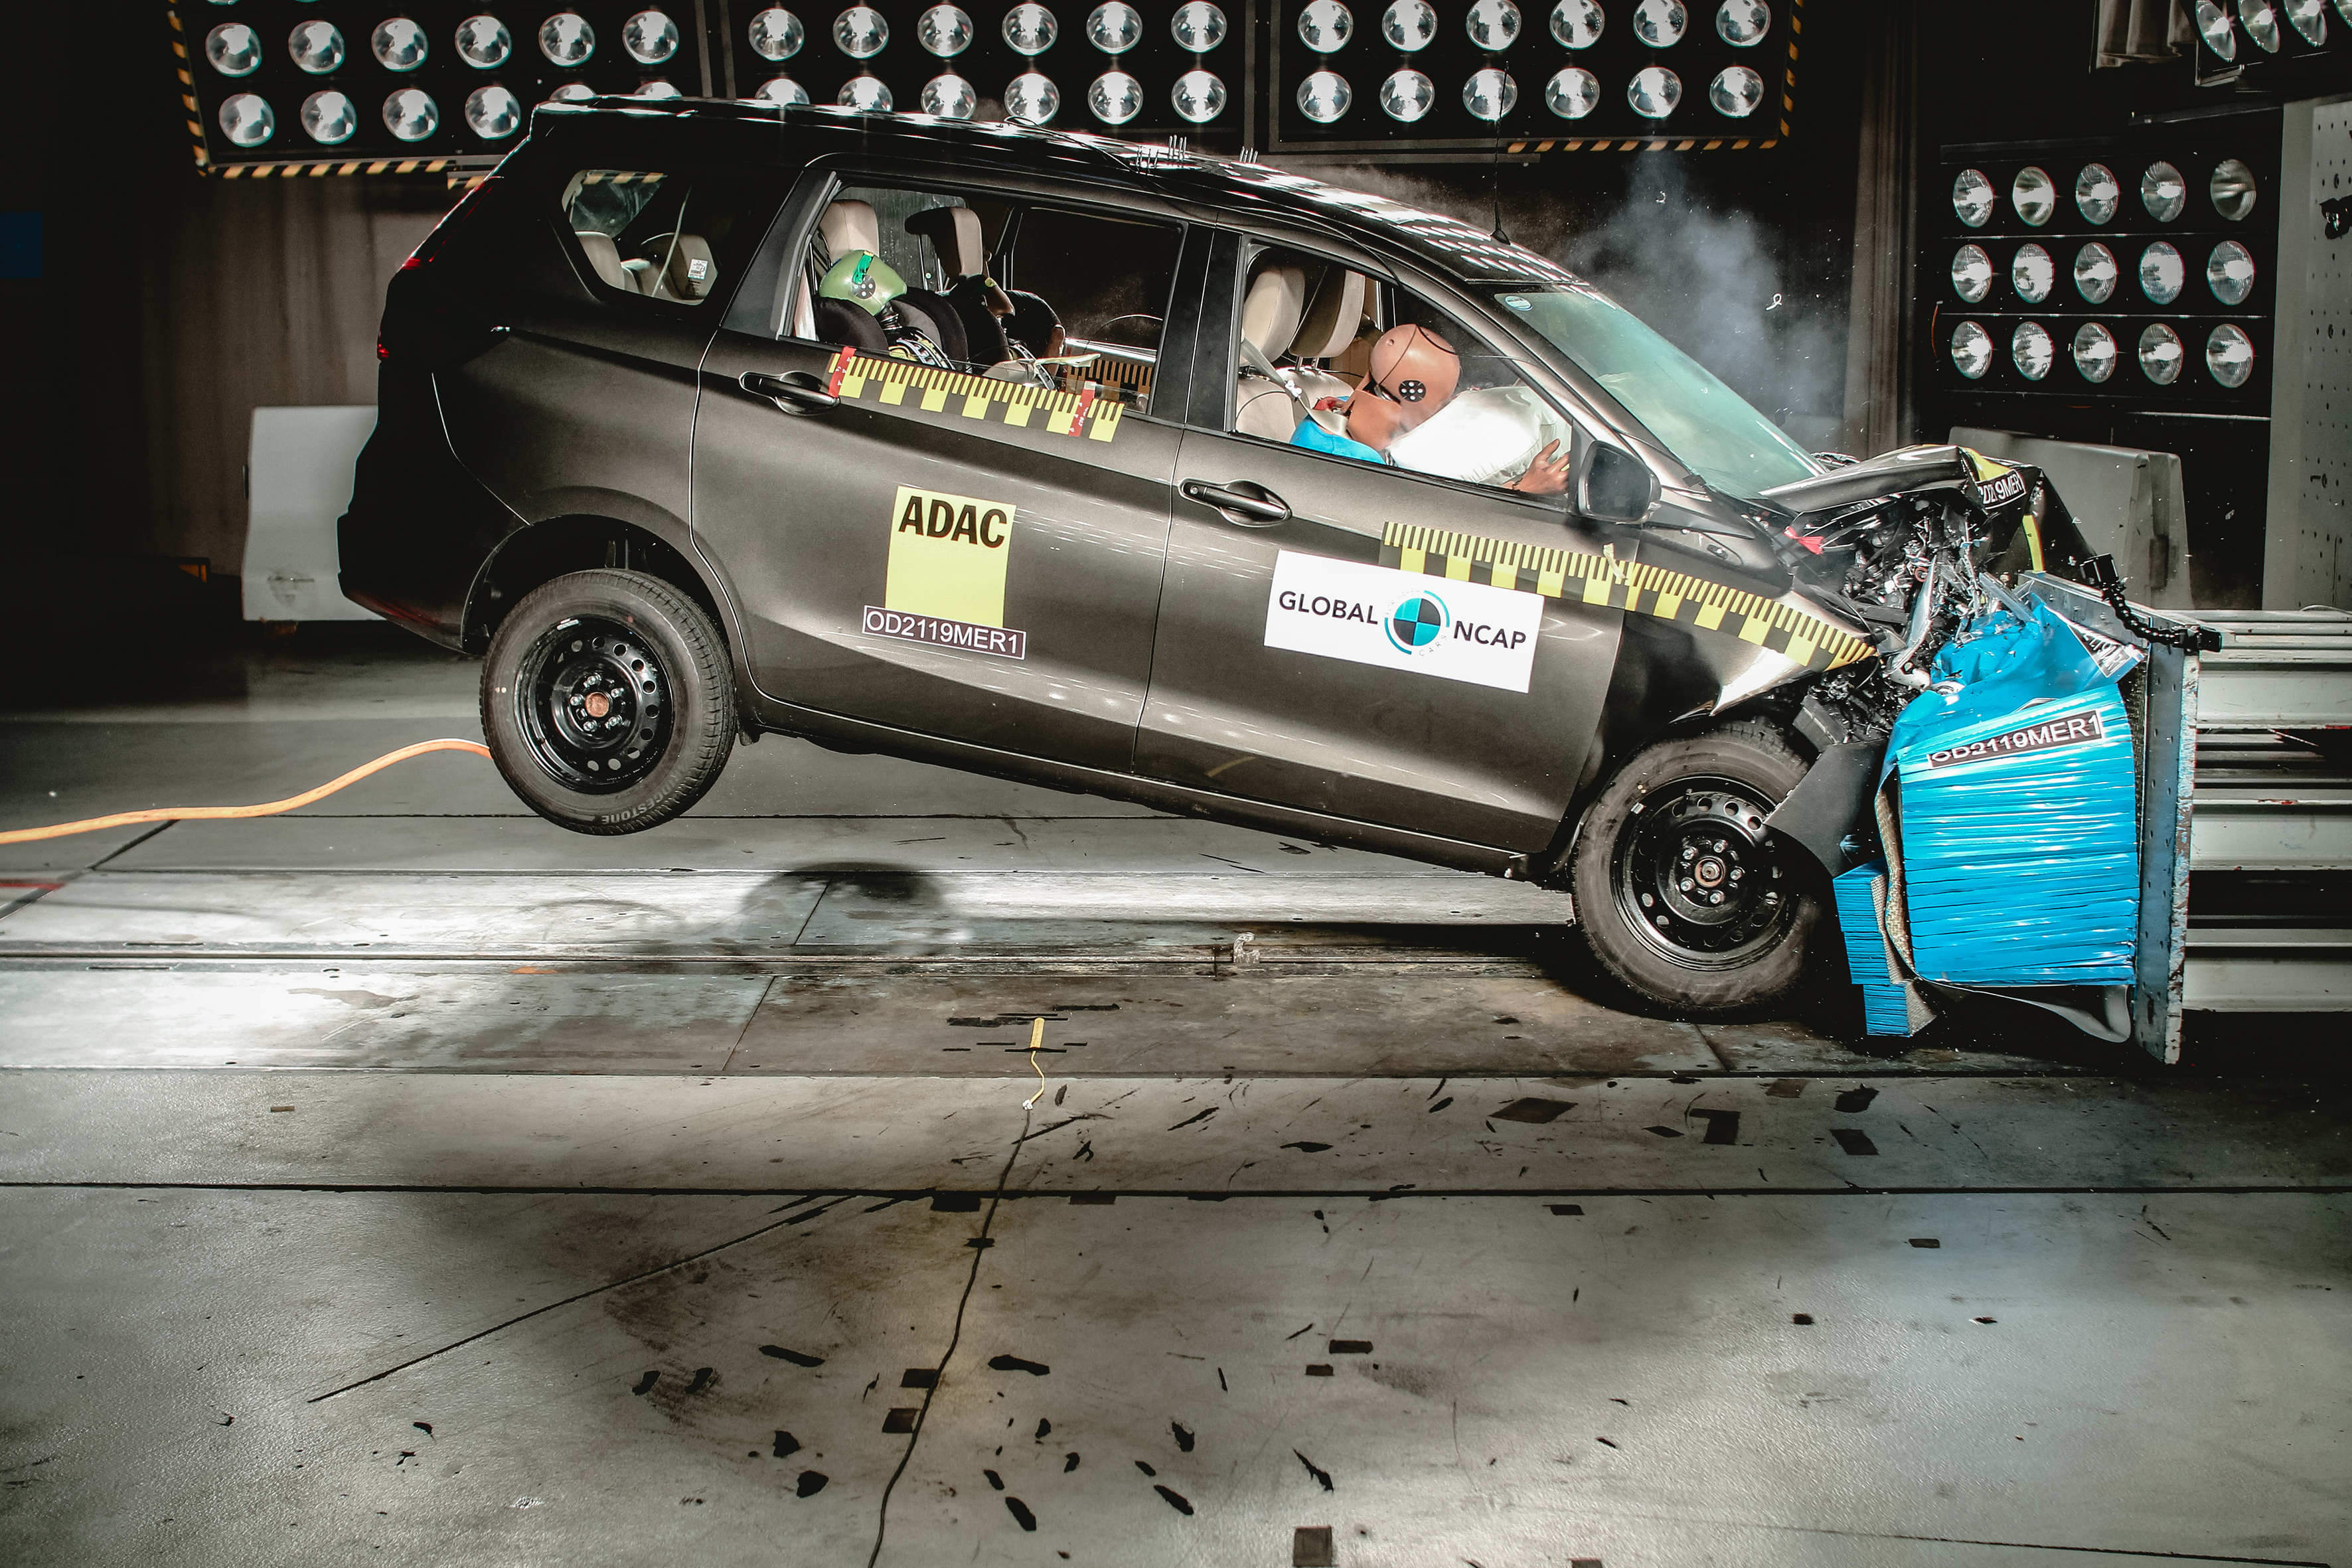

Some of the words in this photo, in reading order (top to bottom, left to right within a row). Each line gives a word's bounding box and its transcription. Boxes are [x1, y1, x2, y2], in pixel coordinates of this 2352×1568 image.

[898, 495, 1007, 548] ADAC
[866, 610, 1018, 655] OD2119MER1
[1279, 590, 1378, 625] GLOBAL
[1453, 620, 1526, 649] NCAP
